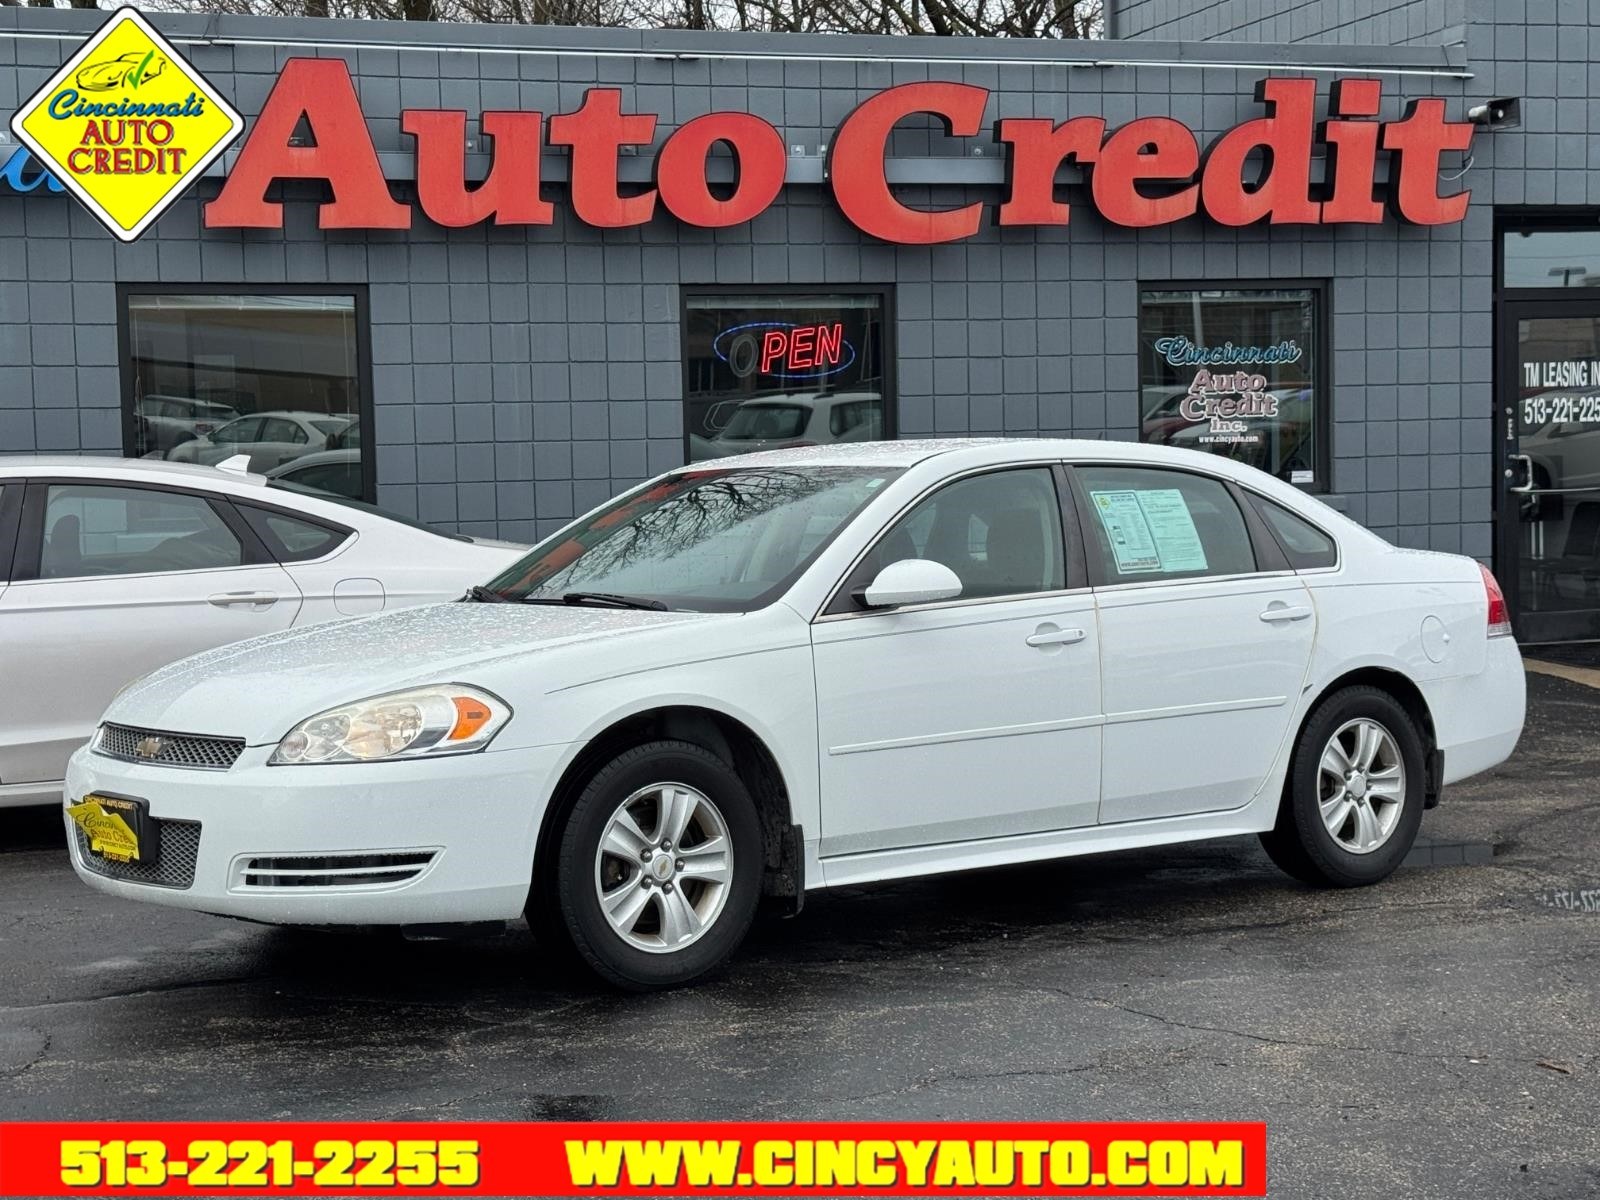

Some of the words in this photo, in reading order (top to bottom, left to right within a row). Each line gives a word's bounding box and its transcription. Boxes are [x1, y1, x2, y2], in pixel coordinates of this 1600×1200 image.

[204, 56, 788, 230] Auto
[827, 77, 1474, 245] Credit
[1154, 335, 1302, 366] Cincinnati
[1188, 368, 1267, 395] Auto
[1523, 362, 1540, 388] TM
[1543, 361, 1588, 387] LEASING
[1180, 392, 1278, 422] Credit
[1210, 418, 1248, 433] Inc.
